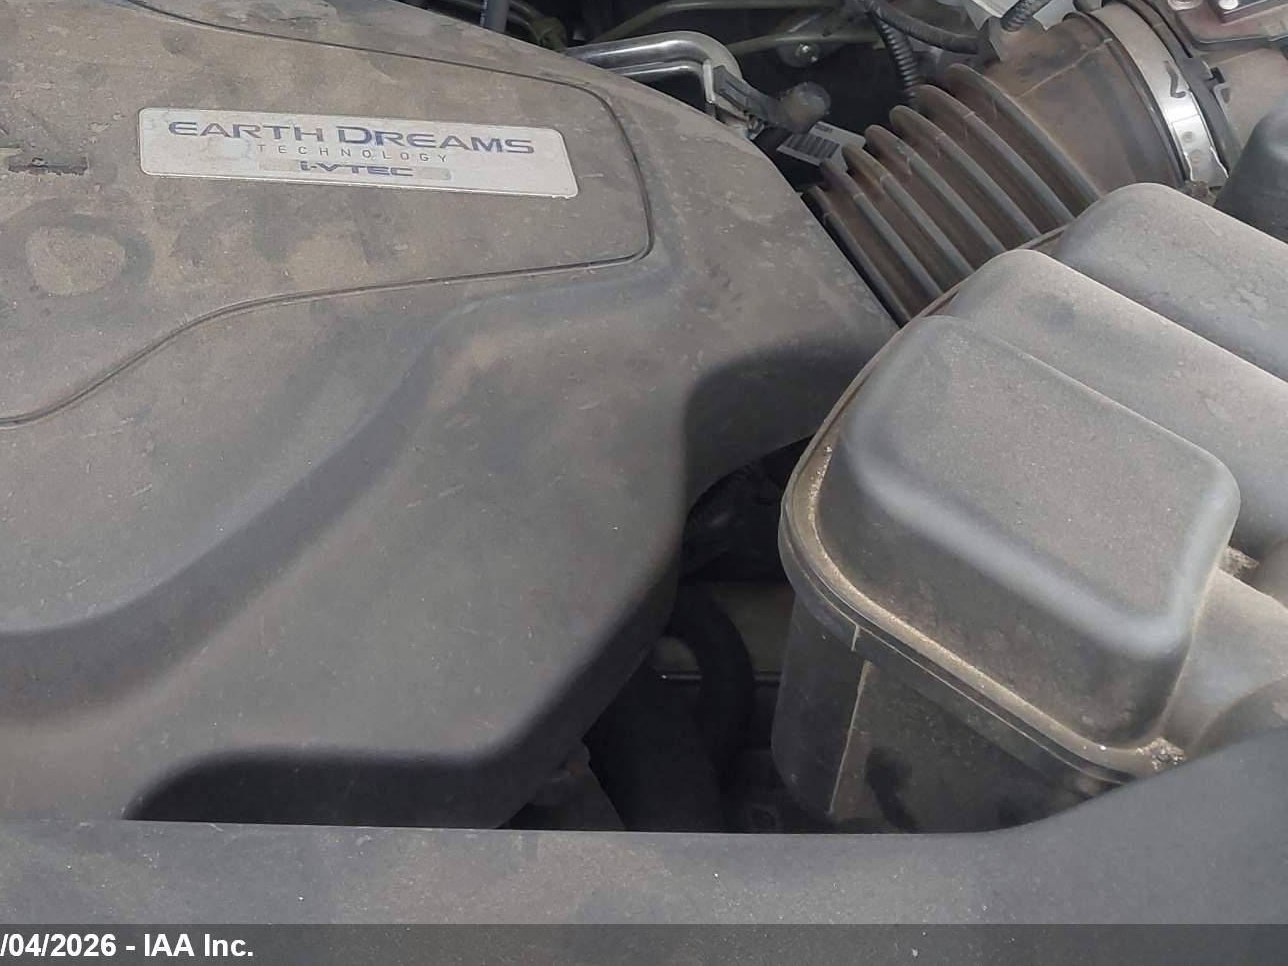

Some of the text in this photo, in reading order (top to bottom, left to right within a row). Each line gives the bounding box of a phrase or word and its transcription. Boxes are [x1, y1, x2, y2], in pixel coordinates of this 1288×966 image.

[168, 121, 536, 155] EARTH DREAMS
[257, 143, 449, 164] TECHNOLOGY
